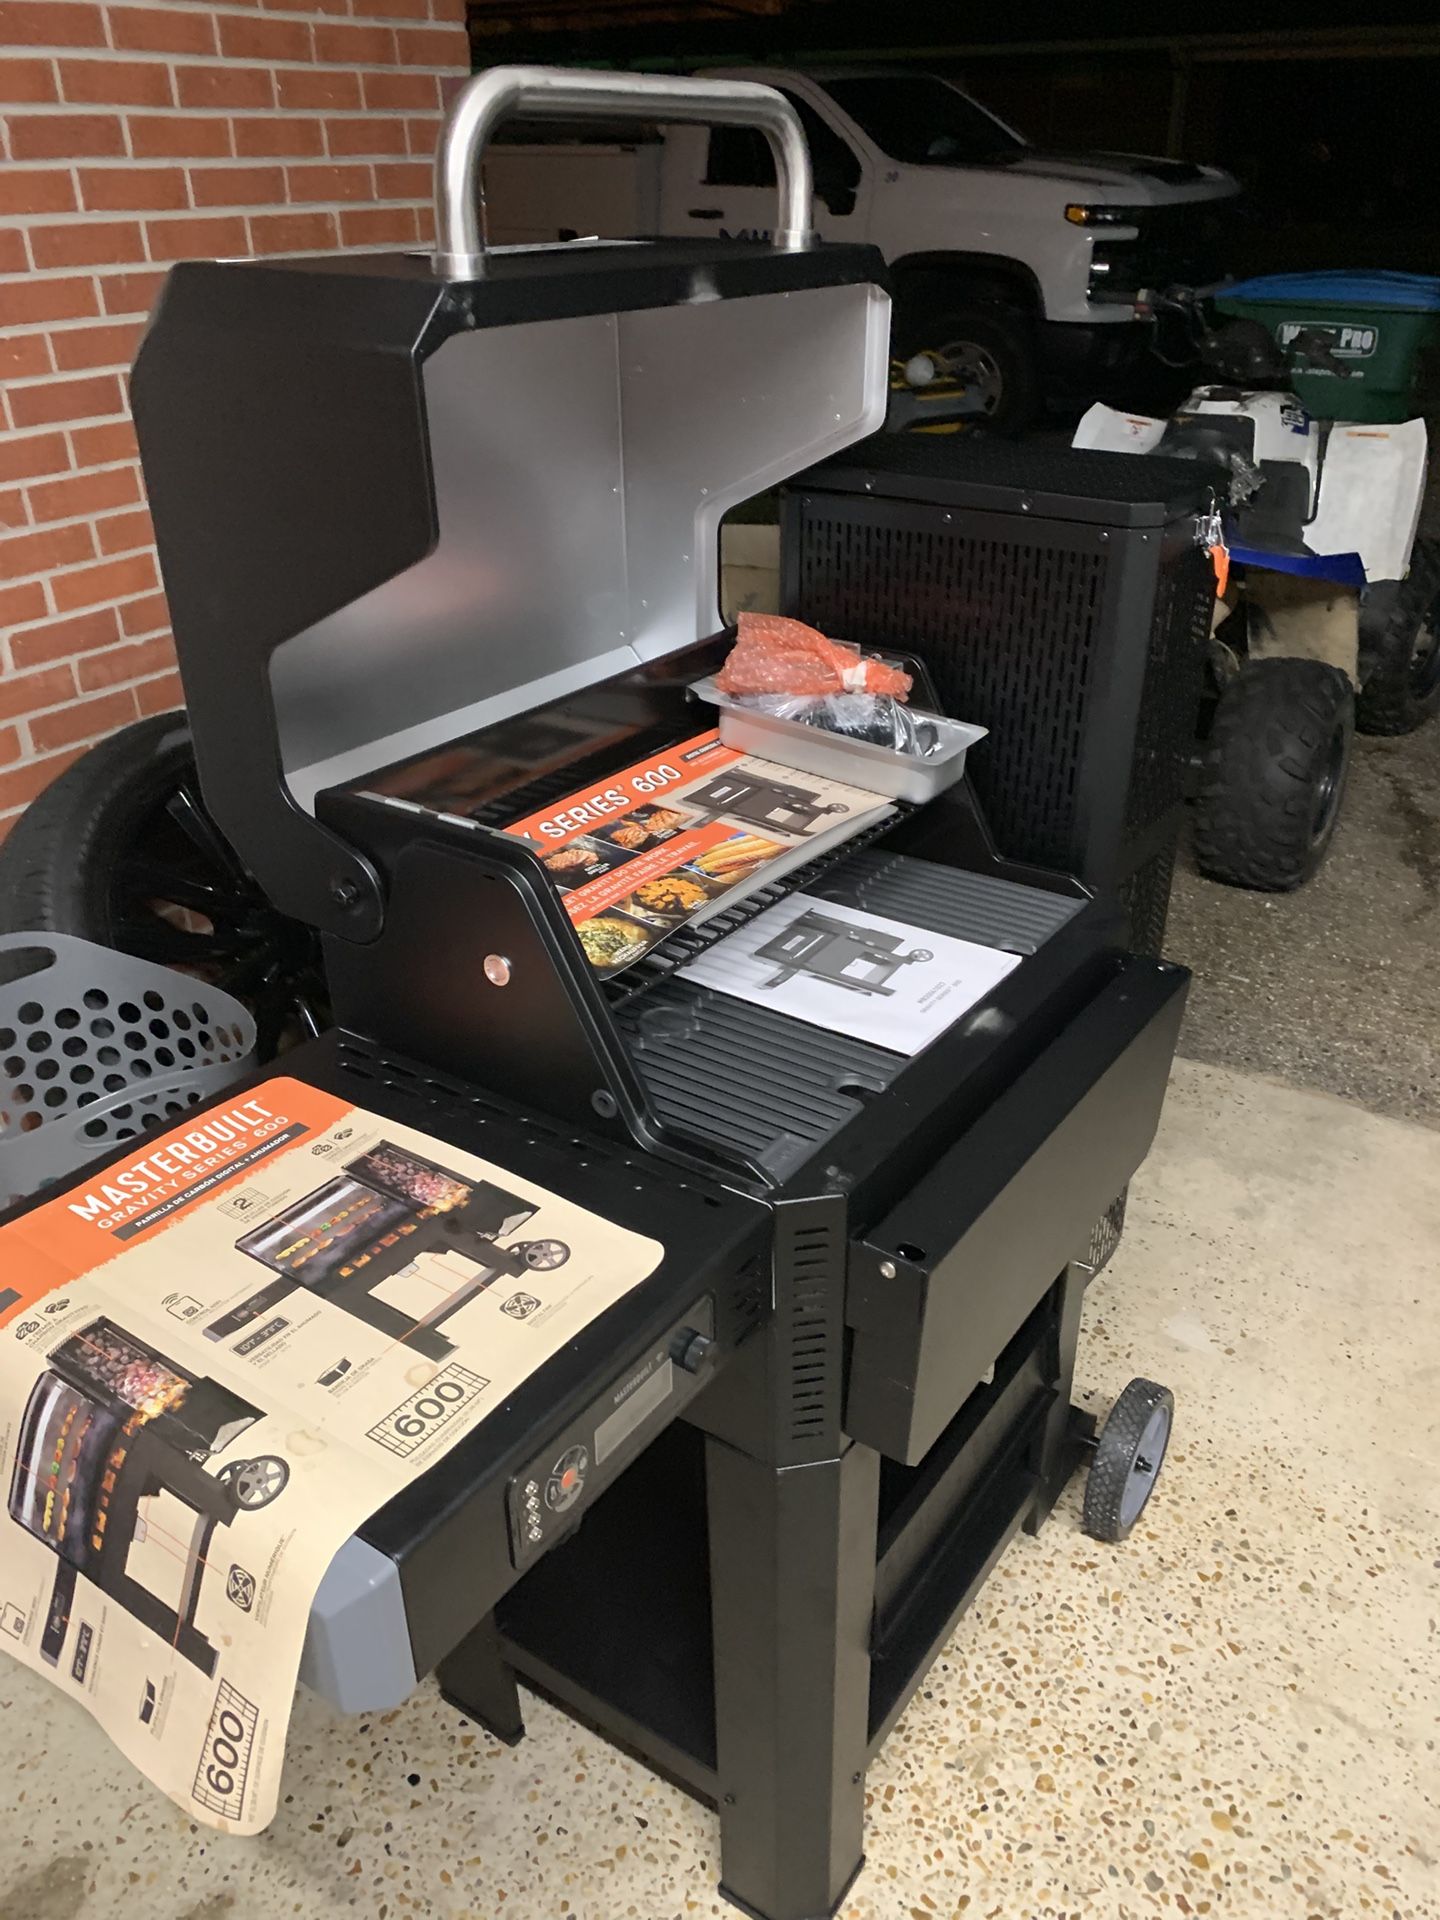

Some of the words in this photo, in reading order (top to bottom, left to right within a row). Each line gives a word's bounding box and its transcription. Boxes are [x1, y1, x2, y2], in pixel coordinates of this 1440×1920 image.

[1340, 328, 1373, 349] PRO
[538, 788, 631, 839] SERIES
[631, 764, 682, 793] 600
[579, 876, 613, 897] GRAVITY
[614, 867, 629, 877] DO
[629, 860, 644, 871] THE
[67, 1100, 273, 1221] MASTERBUILT
[97, 1179, 179, 1229] GRAVITY
[253, 1116, 289, 1137] 600
[135, 1203, 174, 1228] PARRILLA
[173, 1196, 185, 1206] DE
[184, 1176, 216, 1199] CARBÓN
[215, 1160, 245, 1179] DIGITAL
[250, 1132, 290, 1160] AHUMADOR
[233, 1197, 254, 1211] 2
[394, 1381, 465, 1437] 600
[206, 1709, 244, 1795] 600
